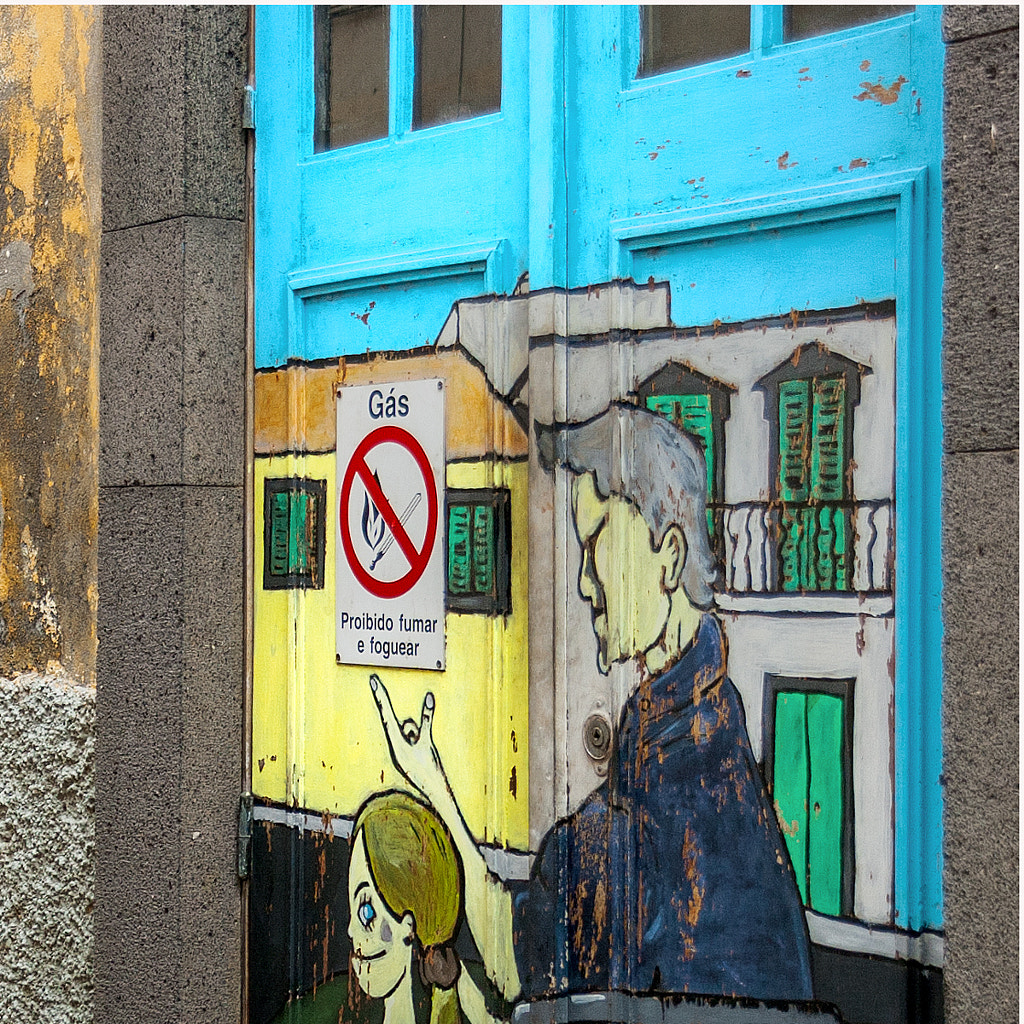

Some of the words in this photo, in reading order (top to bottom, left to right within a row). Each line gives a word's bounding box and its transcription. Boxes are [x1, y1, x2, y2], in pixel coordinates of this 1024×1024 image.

[368, 387, 410, 420] Gás
[341, 611, 394, 632] Proibido
[398, 613, 438, 633] fumar
[357, 639, 365, 653] e
[369, 636, 420, 660] foguear
